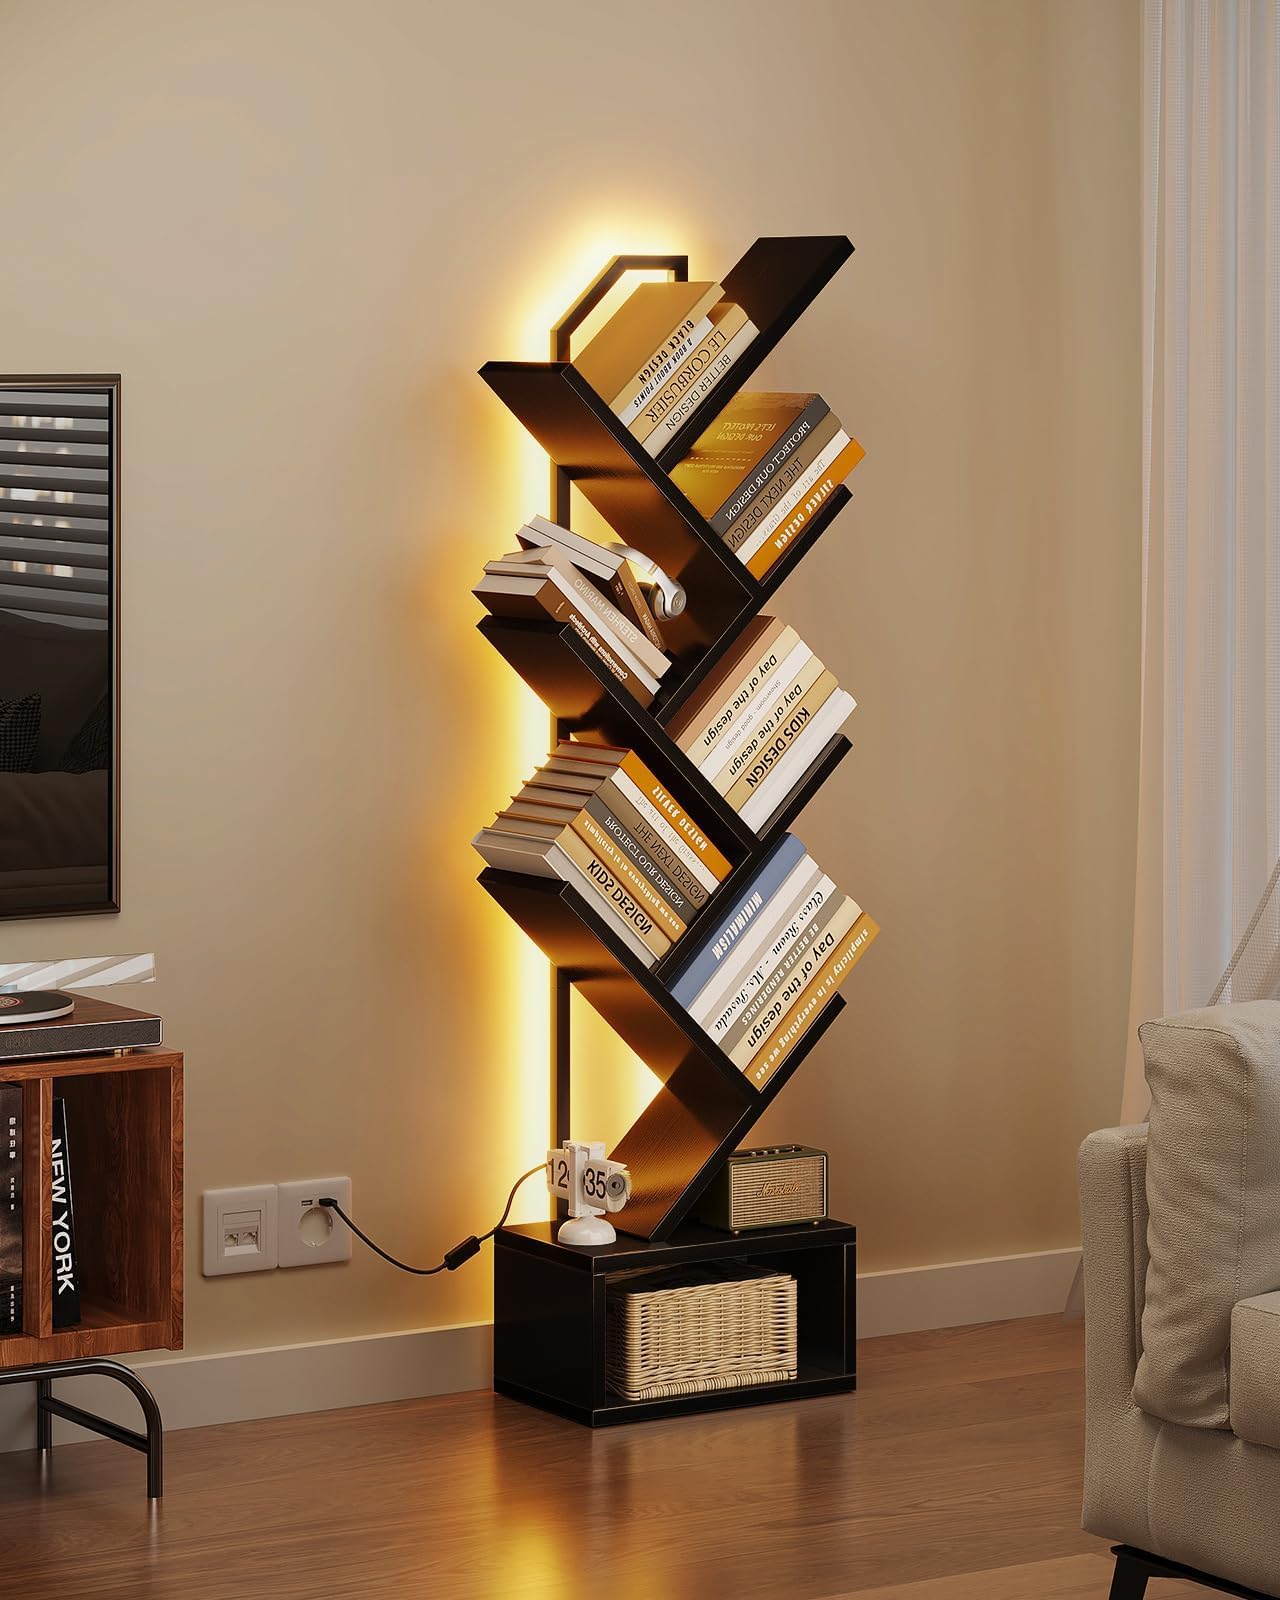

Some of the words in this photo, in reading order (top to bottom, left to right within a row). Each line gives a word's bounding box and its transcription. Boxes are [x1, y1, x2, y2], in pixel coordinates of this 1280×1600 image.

[668, 320, 694, 349] BLACK
[707, 330, 726, 351] LE
[638, 350, 668, 384] DESIGN
[672, 344, 687, 363] BOOK
[645, 349, 711, 423] CORBUSIER
[654, 361, 672, 384] ABOUT
[699, 354, 731, 391] BETTER
[634, 383, 654, 407] POINTS
[666, 390, 700, 430] DESIGN
[759, 654, 777, 677] Day
[749, 677, 759, 692] of
[756, 680, 781, 711] Showroom
[784, 684, 802, 707] Day
[733, 690, 749, 710] the
[774, 707, 784, 722] of
[704, 710, 733, 746] design
[758, 720, 774, 739] the
[784, 707, 810, 740] KIDS
[725, 730, 741, 750] design
[729, 739, 758, 775] design
[746, 738, 786, 787] DESIGN
[799, 891, 823, 921] Class
[712, 892, 762, 959] MINIMALISM
[773, 922, 799, 955] Room
[808, 923, 819, 937] BE
[784, 936, 809, 969] BETTER
[813, 933, 835, 961] Day
[833, 929, 868, 976] simplicity
[801, 961, 813, 980] of
[826, 975, 835, 986] is
[742, 969, 784, 1025] RENDERINGS
[782, 977, 801, 1001] the
[817, 986, 827, 997] in
[715, 989, 748, 1030] Posada
[748, 1002, 782, 1047] design
[779, 998, 817, 1048] everything
[769, 1048, 780, 1062] we
[756, 1062, 769, 1080] see
[52, 1139, 67, 1204] NEW
[585, 1167, 606, 1199] 35
[52, 1210, 75, 1295] YORK
